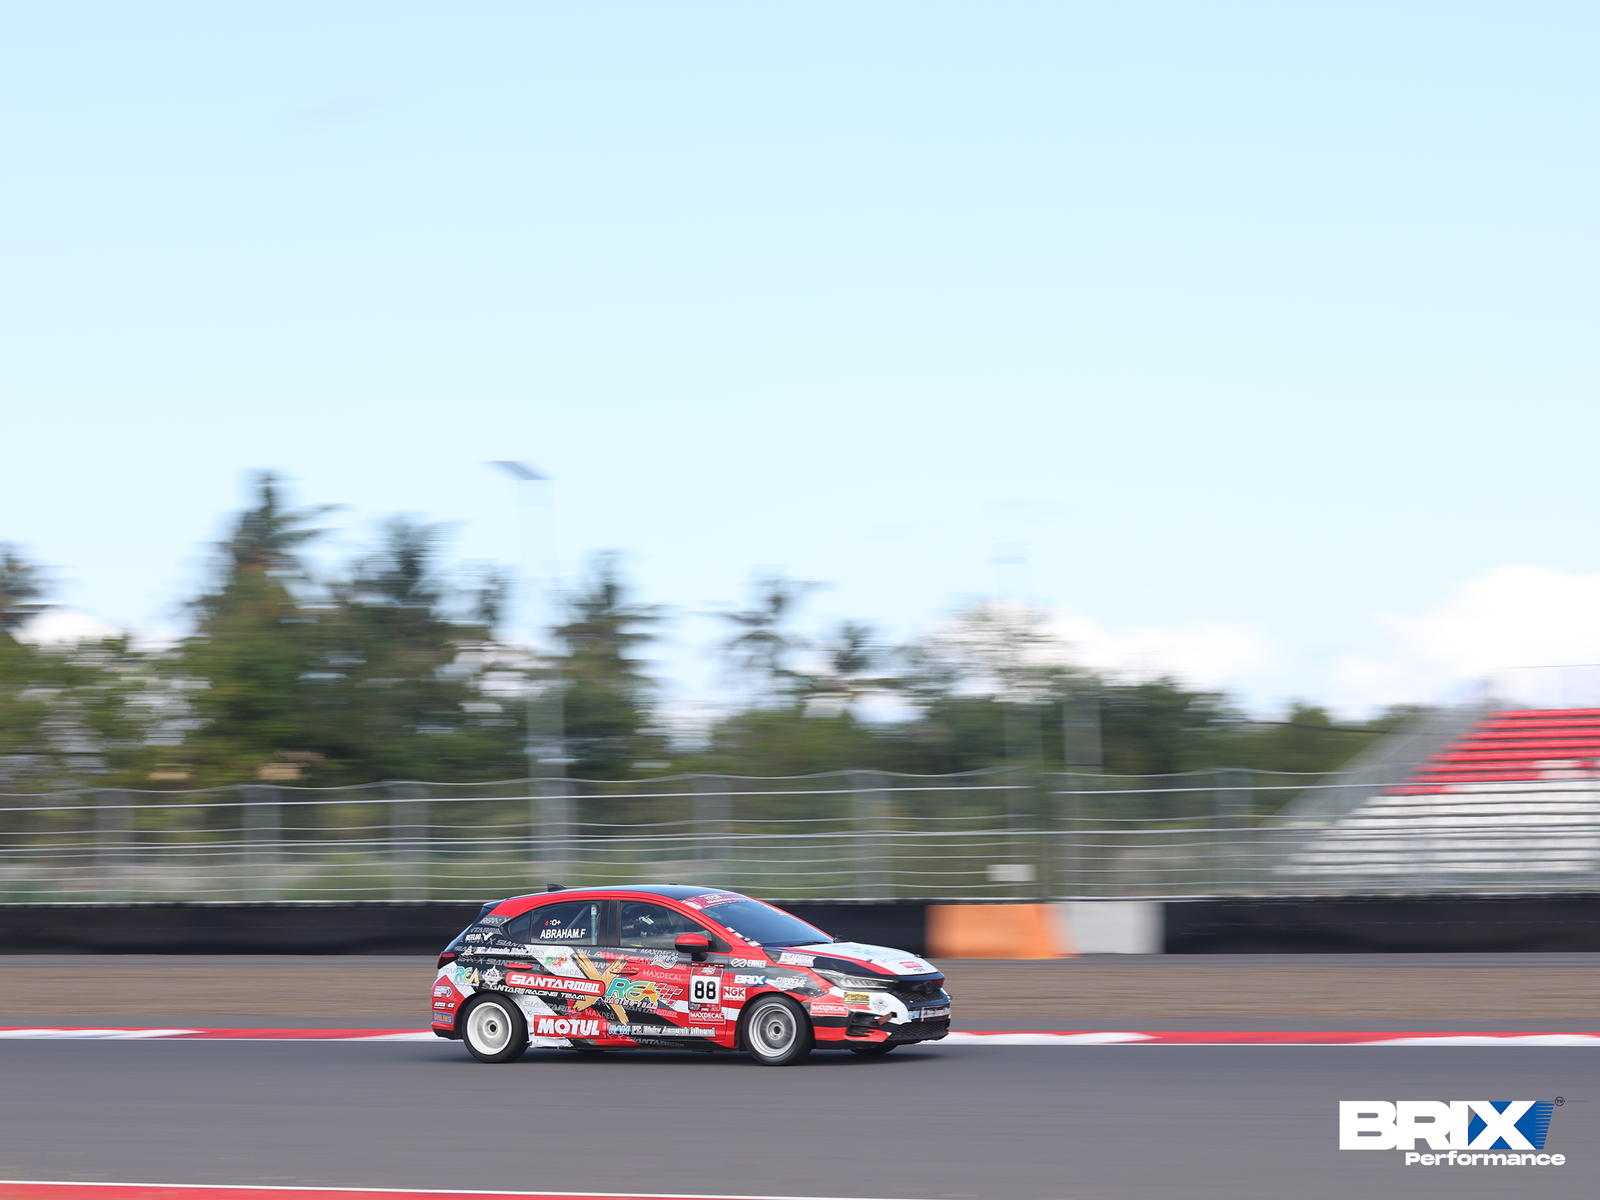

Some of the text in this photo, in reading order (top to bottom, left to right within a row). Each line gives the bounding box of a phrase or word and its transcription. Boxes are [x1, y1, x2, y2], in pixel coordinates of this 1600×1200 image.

[642, 968, 683, 982] MAXDECAL
[734, 974, 767, 985] BRIX
[525, 988, 559, 998] RACING
[560, 992, 586, 1002] TEAM
[694, 980, 717, 1001] 88
[723, 987, 745, 997] NGK
[812, 1004, 846, 1013] MAXDECAL
[690, 1012, 723, 1021] MAXDECAL
[537, 1018, 600, 1036] MOTUL
